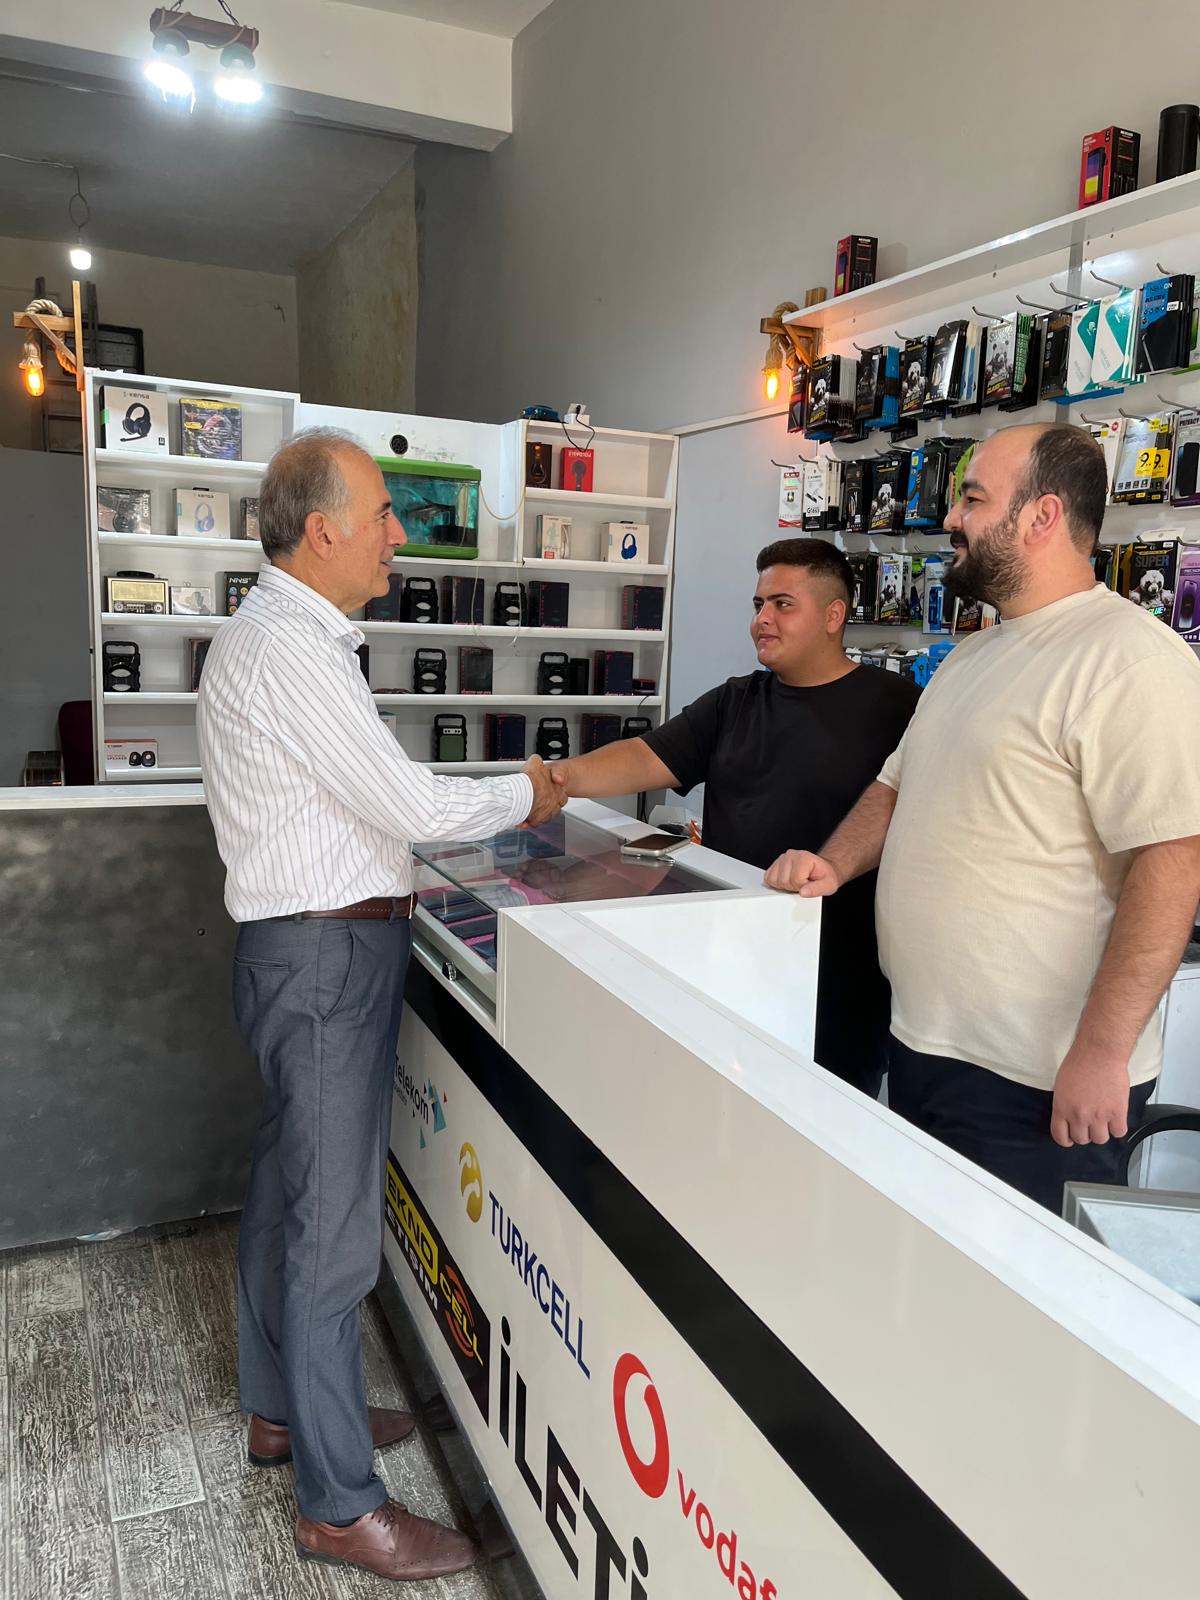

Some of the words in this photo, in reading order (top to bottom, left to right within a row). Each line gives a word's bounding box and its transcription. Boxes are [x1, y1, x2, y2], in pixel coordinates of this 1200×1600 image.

[1135, 554, 1170, 568] SUPER
[387, 1173, 435, 1270] EKNO
[439, 1272, 484, 1367] CELL
[489, 1190, 591, 1380] TURKCELL
